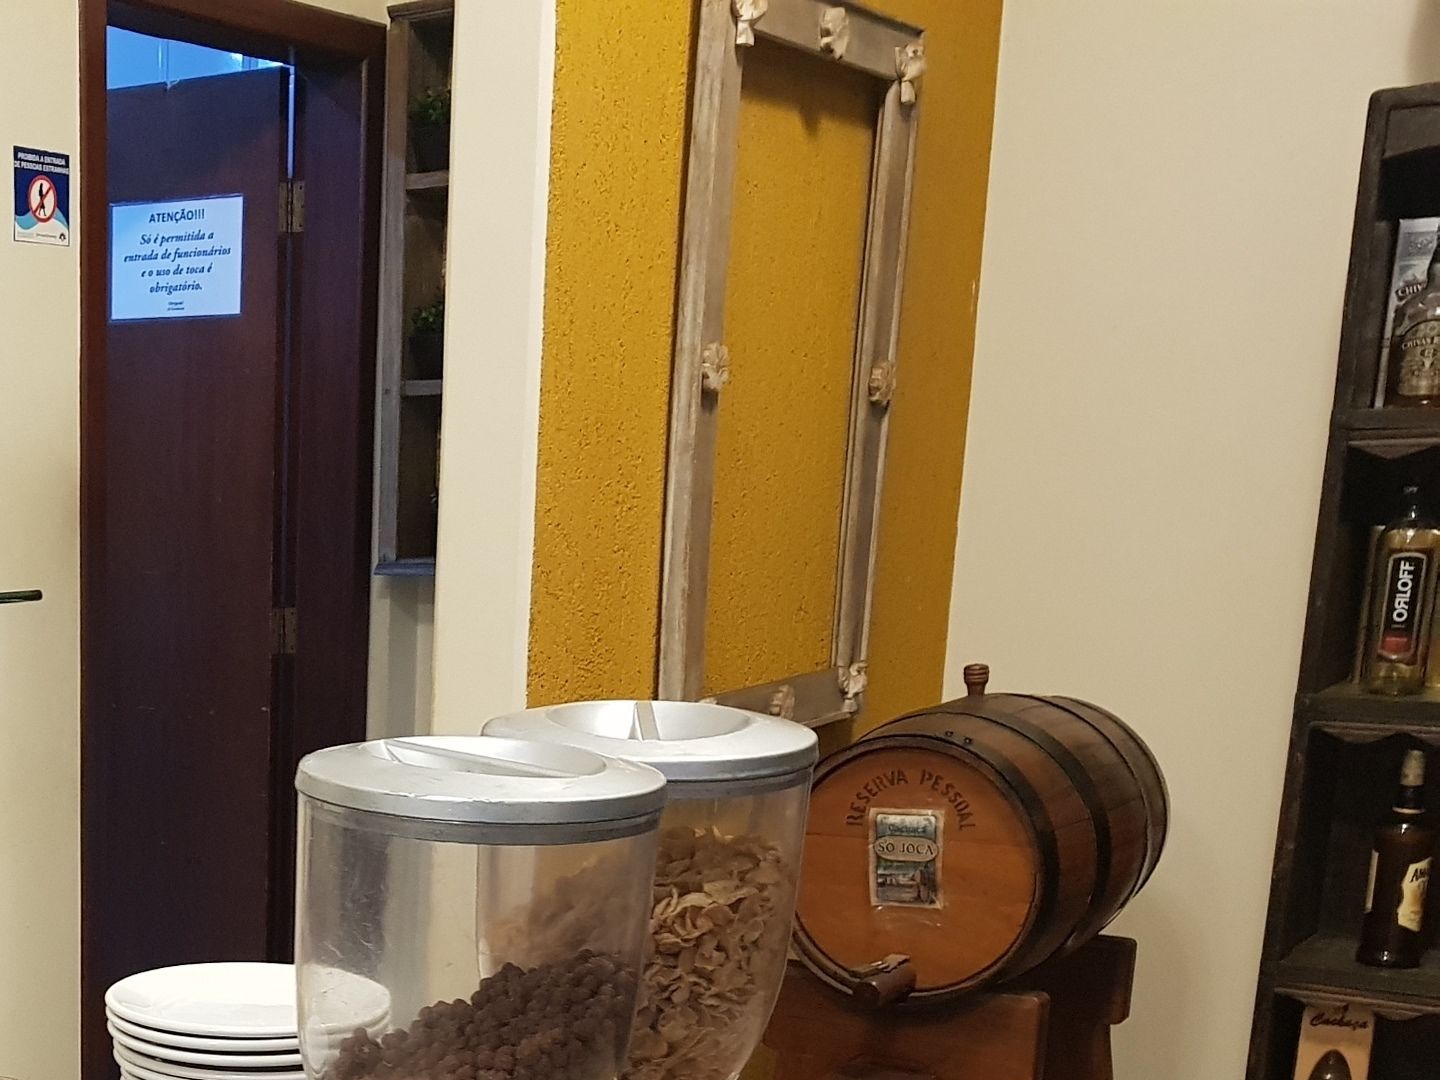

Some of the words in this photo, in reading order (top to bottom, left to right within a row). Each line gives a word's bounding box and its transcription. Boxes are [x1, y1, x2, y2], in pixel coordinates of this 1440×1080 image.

[148, 208, 205, 224] ATENÇÃO!!!
[140, 233, 152, 245] Só
[153, 233, 160, 244] é
[159, 229, 206, 247] permitida
[207, 231, 215, 240] a
[123, 249, 159, 263] entrada
[160, 248, 172, 260] de
[171, 245, 231, 263] funcionários
[141, 270, 147, 278] e
[147, 269, 154, 277] o
[156, 268, 171, 277] uso
[172, 264, 184, 276] de
[185, 265, 205, 275] toca
[207, 262, 213, 273] é
[149, 280, 203, 296] obrigatório.
[1397, 282, 1426, 297] CHIV
[1392, 560, 1415, 623] ORLOFF
[846, 768, 909, 827] RESERVA
[919, 769, 976, 831] PESSOAL
[899, 842, 933, 855] JOCA
